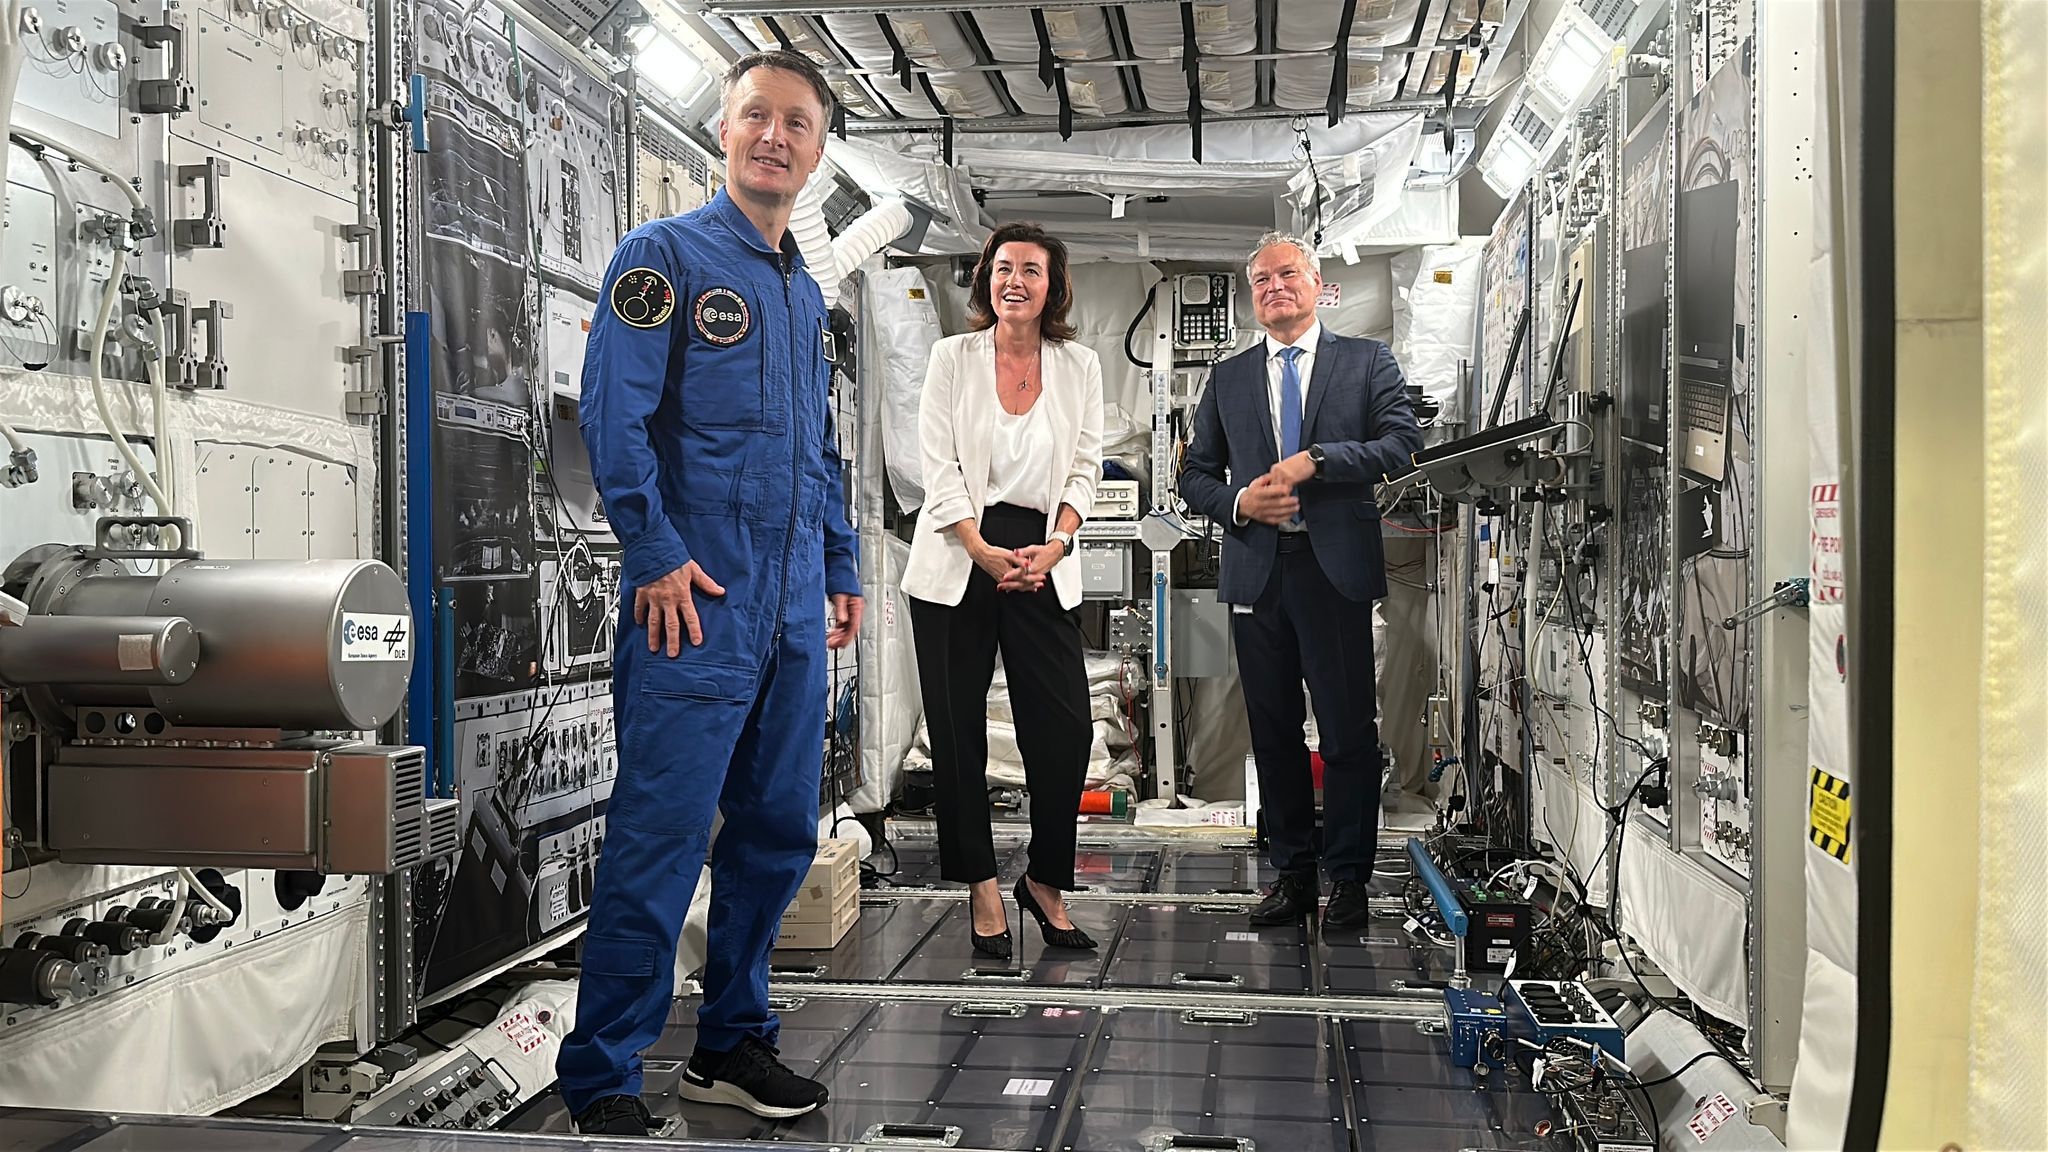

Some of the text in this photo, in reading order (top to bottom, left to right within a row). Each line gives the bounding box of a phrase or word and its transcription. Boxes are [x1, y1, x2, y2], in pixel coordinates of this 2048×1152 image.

[718, 311, 742, 323] esa
[357, 625, 378, 641] esa
[394, 649, 406, 659] DLR
